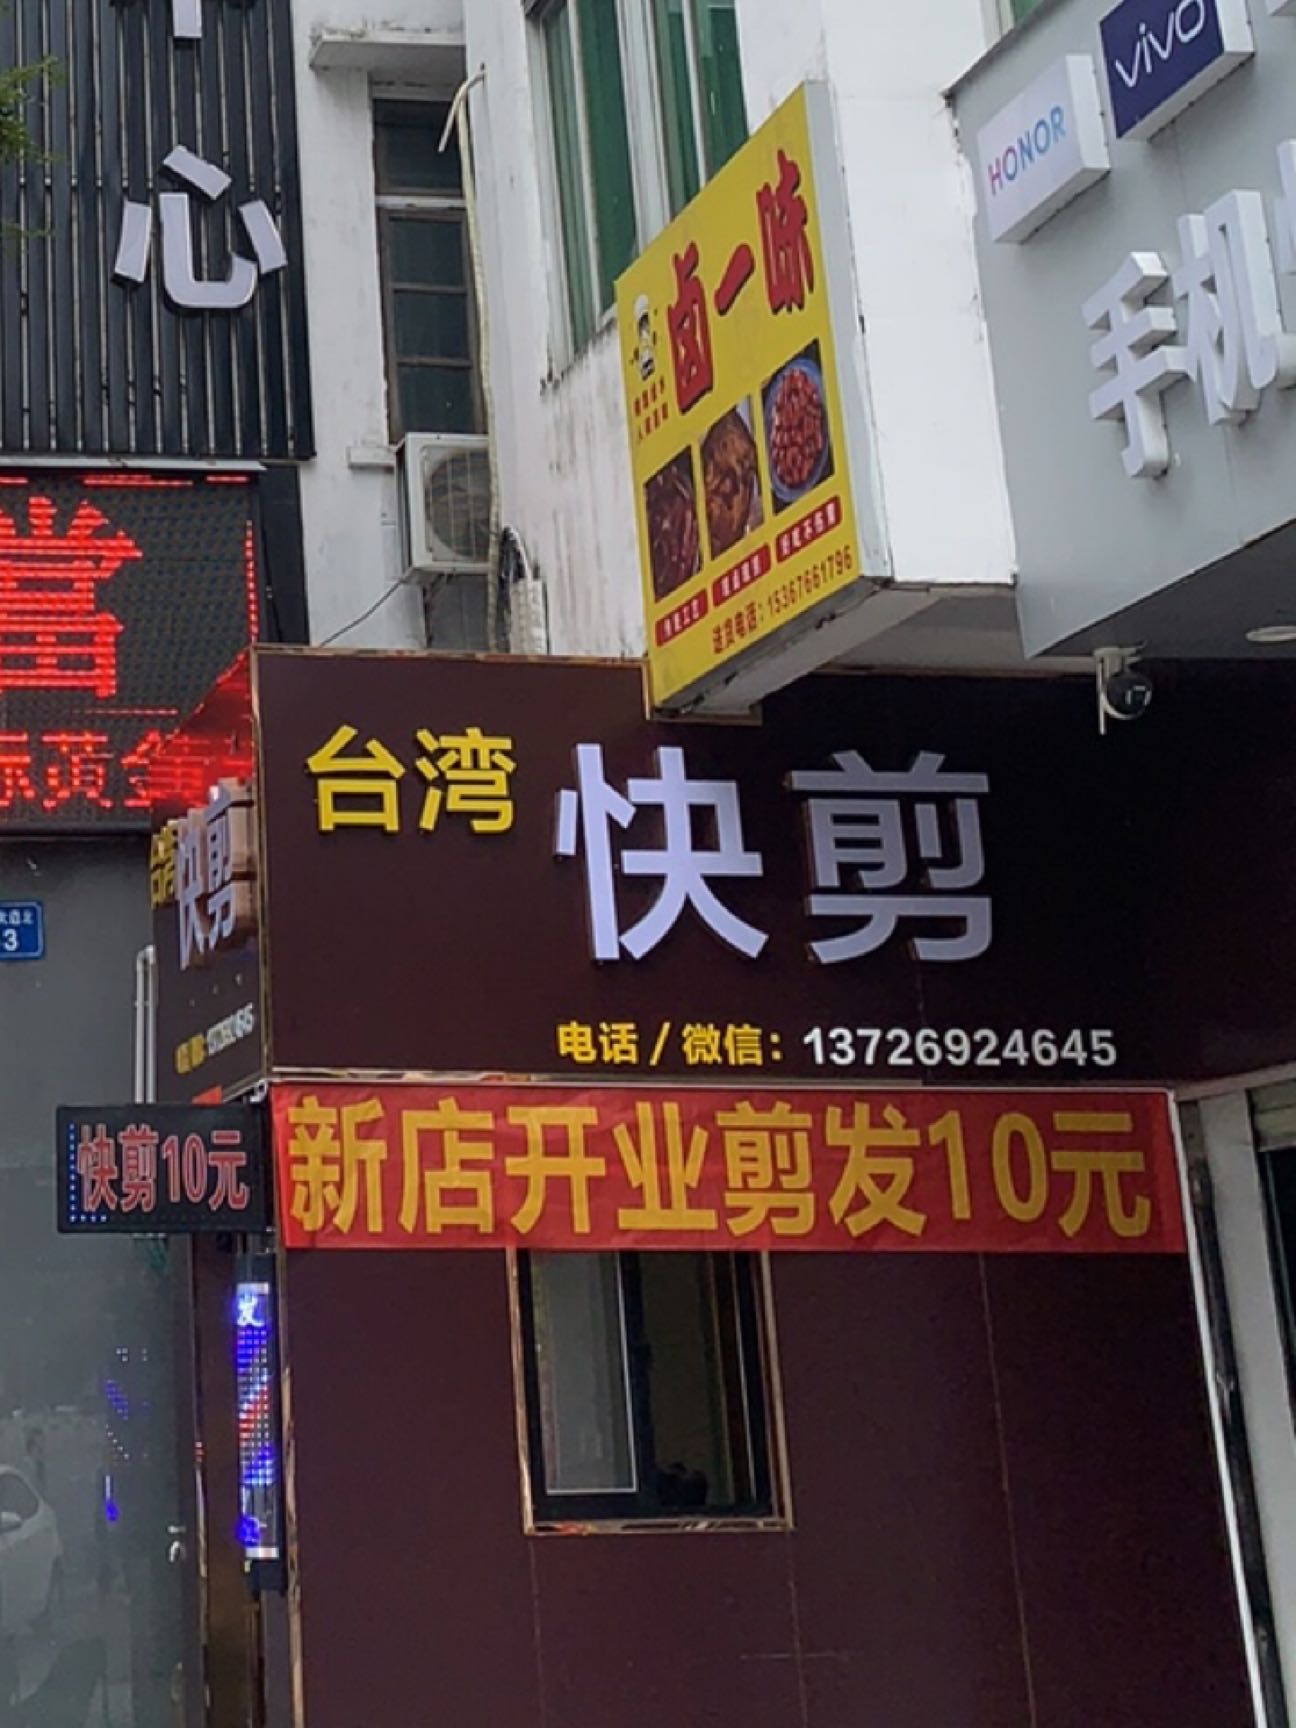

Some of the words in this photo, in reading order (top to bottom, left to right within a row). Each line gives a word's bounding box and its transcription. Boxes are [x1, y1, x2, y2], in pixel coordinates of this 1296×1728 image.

[987, 106, 1066, 196] HONOR
[1082, 137, 1296, 478] 手机
[306, 723, 516, 834] 台湾
[554, 742, 994, 966] 快剪
[801, 1025, 1118, 1069] 13726924645
[77, 1123, 250, 1214] 快剪10元
[286, 1094, 1153, 1240] 新店开业剪发10元
